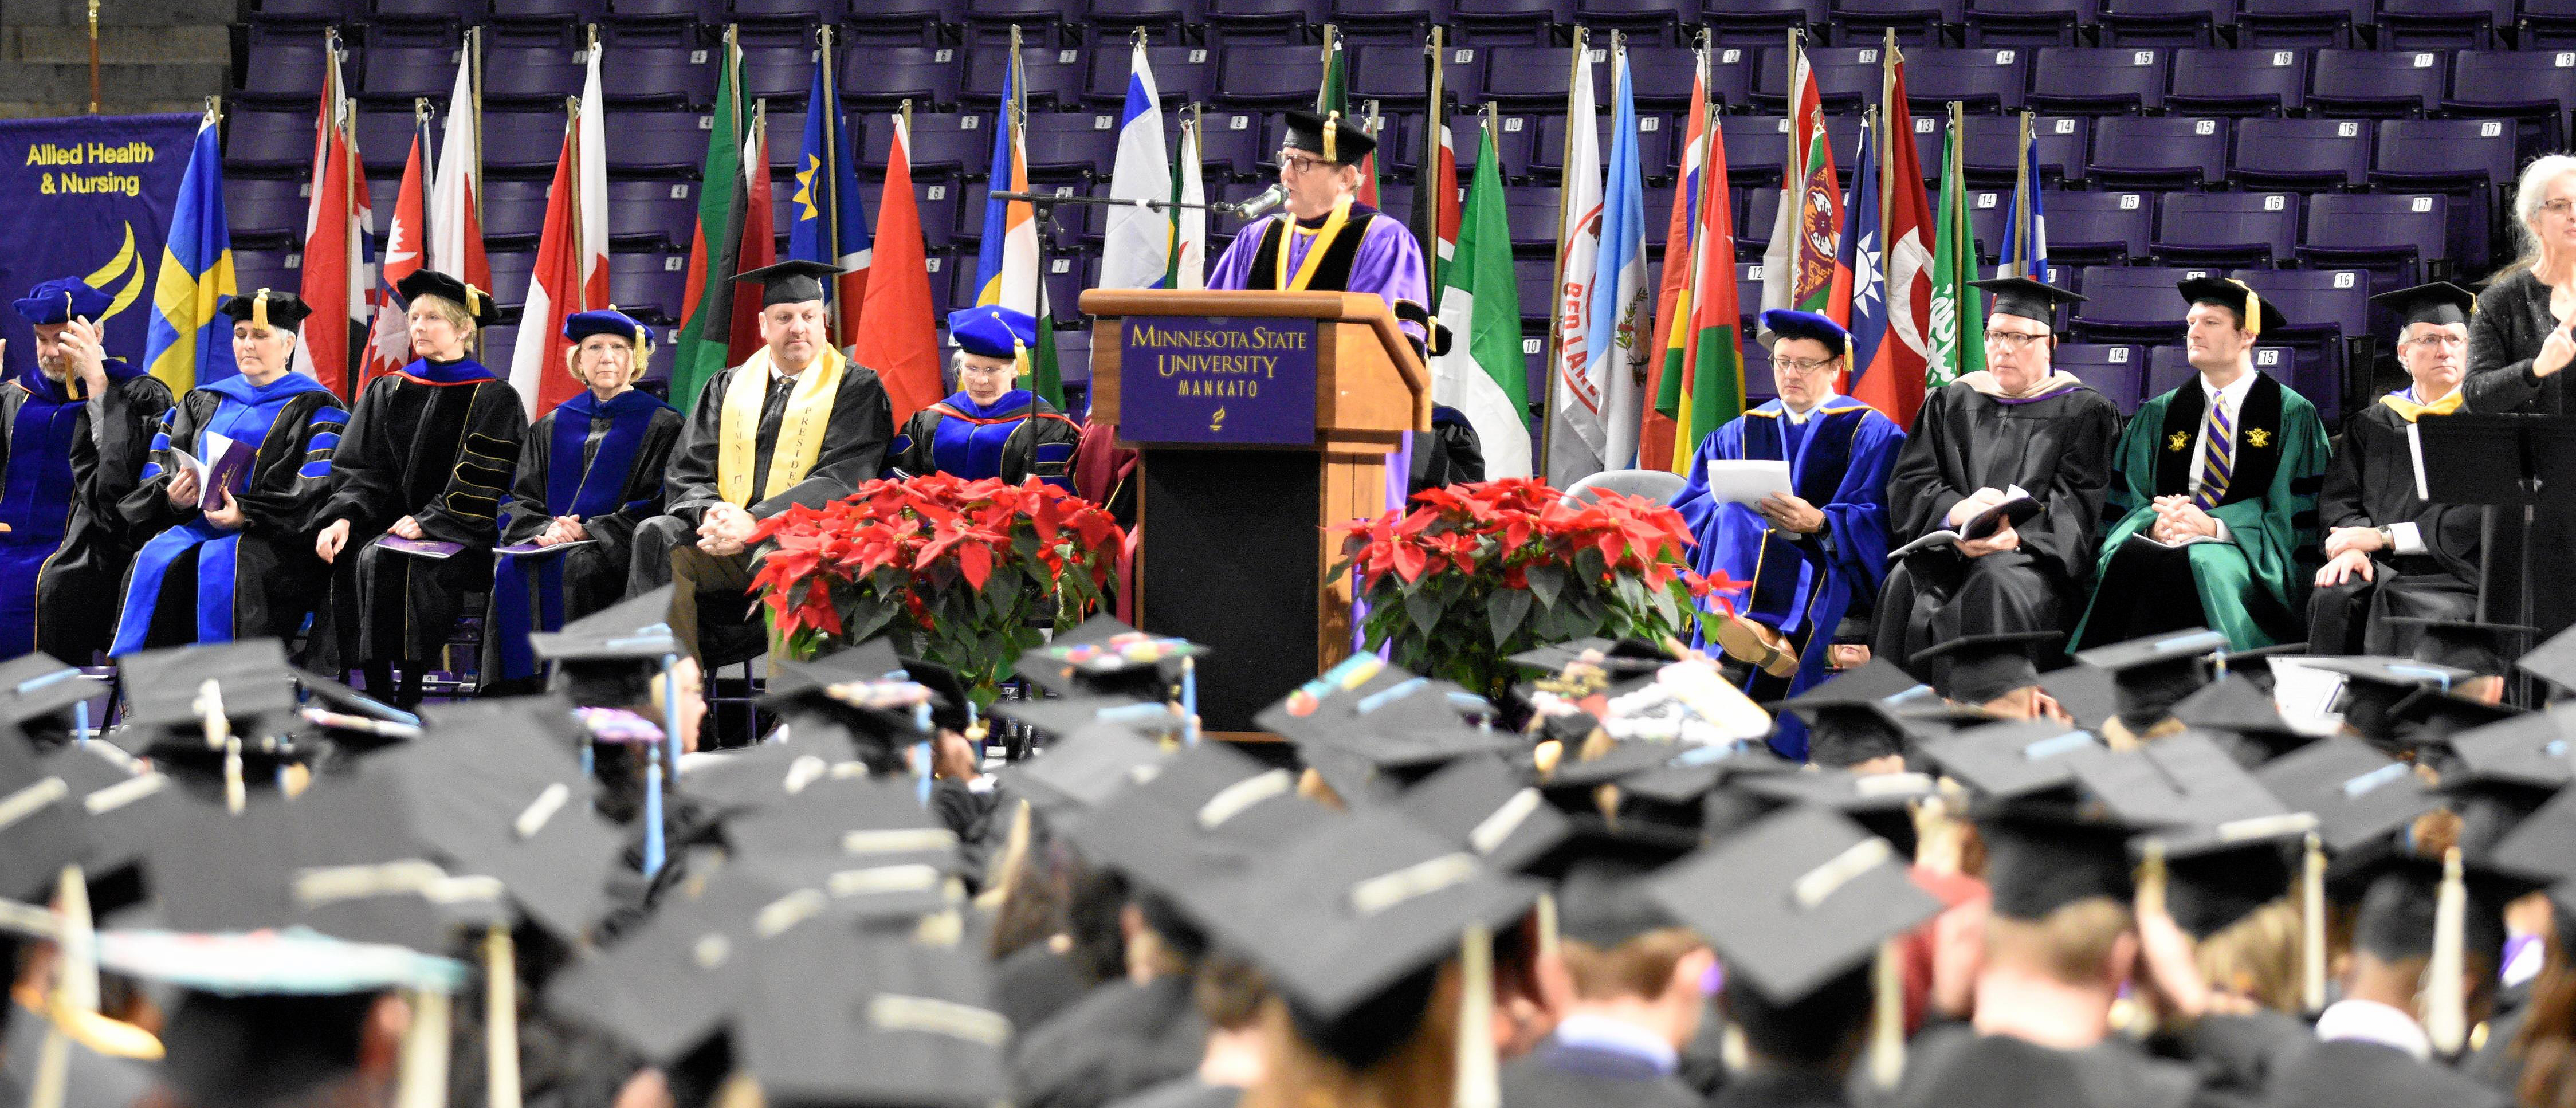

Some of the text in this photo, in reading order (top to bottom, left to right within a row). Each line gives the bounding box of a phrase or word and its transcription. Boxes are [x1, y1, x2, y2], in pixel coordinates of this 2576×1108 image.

[1460, 50, 1469, 61] 10
[1593, 49, 1602, 61] 11
[1728, 50, 1737, 62] 12
[1864, 49, 1873, 62] 13
[2001, 52, 2011, 62] 14
[2139, 52, 2149, 64] 15
[2279, 53, 2288, 64] 16
[2419, 54, 2429, 65] 17
[2561, 54, 2571, 65] 18
[967, 116, 972, 128] 6
[1102, 116, 1106, 128] 7
[1236, 117, 1242, 128] 8
[1509, 118, 1518, 130] 10
[1646, 118, 1655, 130] 11
[1921, 119, 1931, 131] 13
[2060, 120, 2071, 132] 14
[2200, 121, 2210, 133] 15
[2343, 123, 2354, 135] 16
[2487, 123, 2496, 135] 17
[26, 141, 154, 166] Allied Health
[40, 171, 139, 197] & Nursing
[934, 186, 939, 198] 6
[1982, 195, 1993, 206] 14
[2125, 196, 2135, 207] 15
[2269, 197, 2280, 209] 16
[2417, 198, 2427, 210] 17
[929, 259, 934, 270] 6
[1059, 260, 1063, 272] 7
[1753, 267, 1763, 278] 12
[2339, 274, 2350, 286] 16
[1131, 324, 1306, 349] MINNESOTA STATE
[1526, 340, 1537, 352] 10
[2114, 349, 2124, 361] 14
[2263, 352, 2273, 364] 15
[1159, 355, 1278, 378] UNIVERSITY
[1179, 380, 1257, 398] MANKATO
